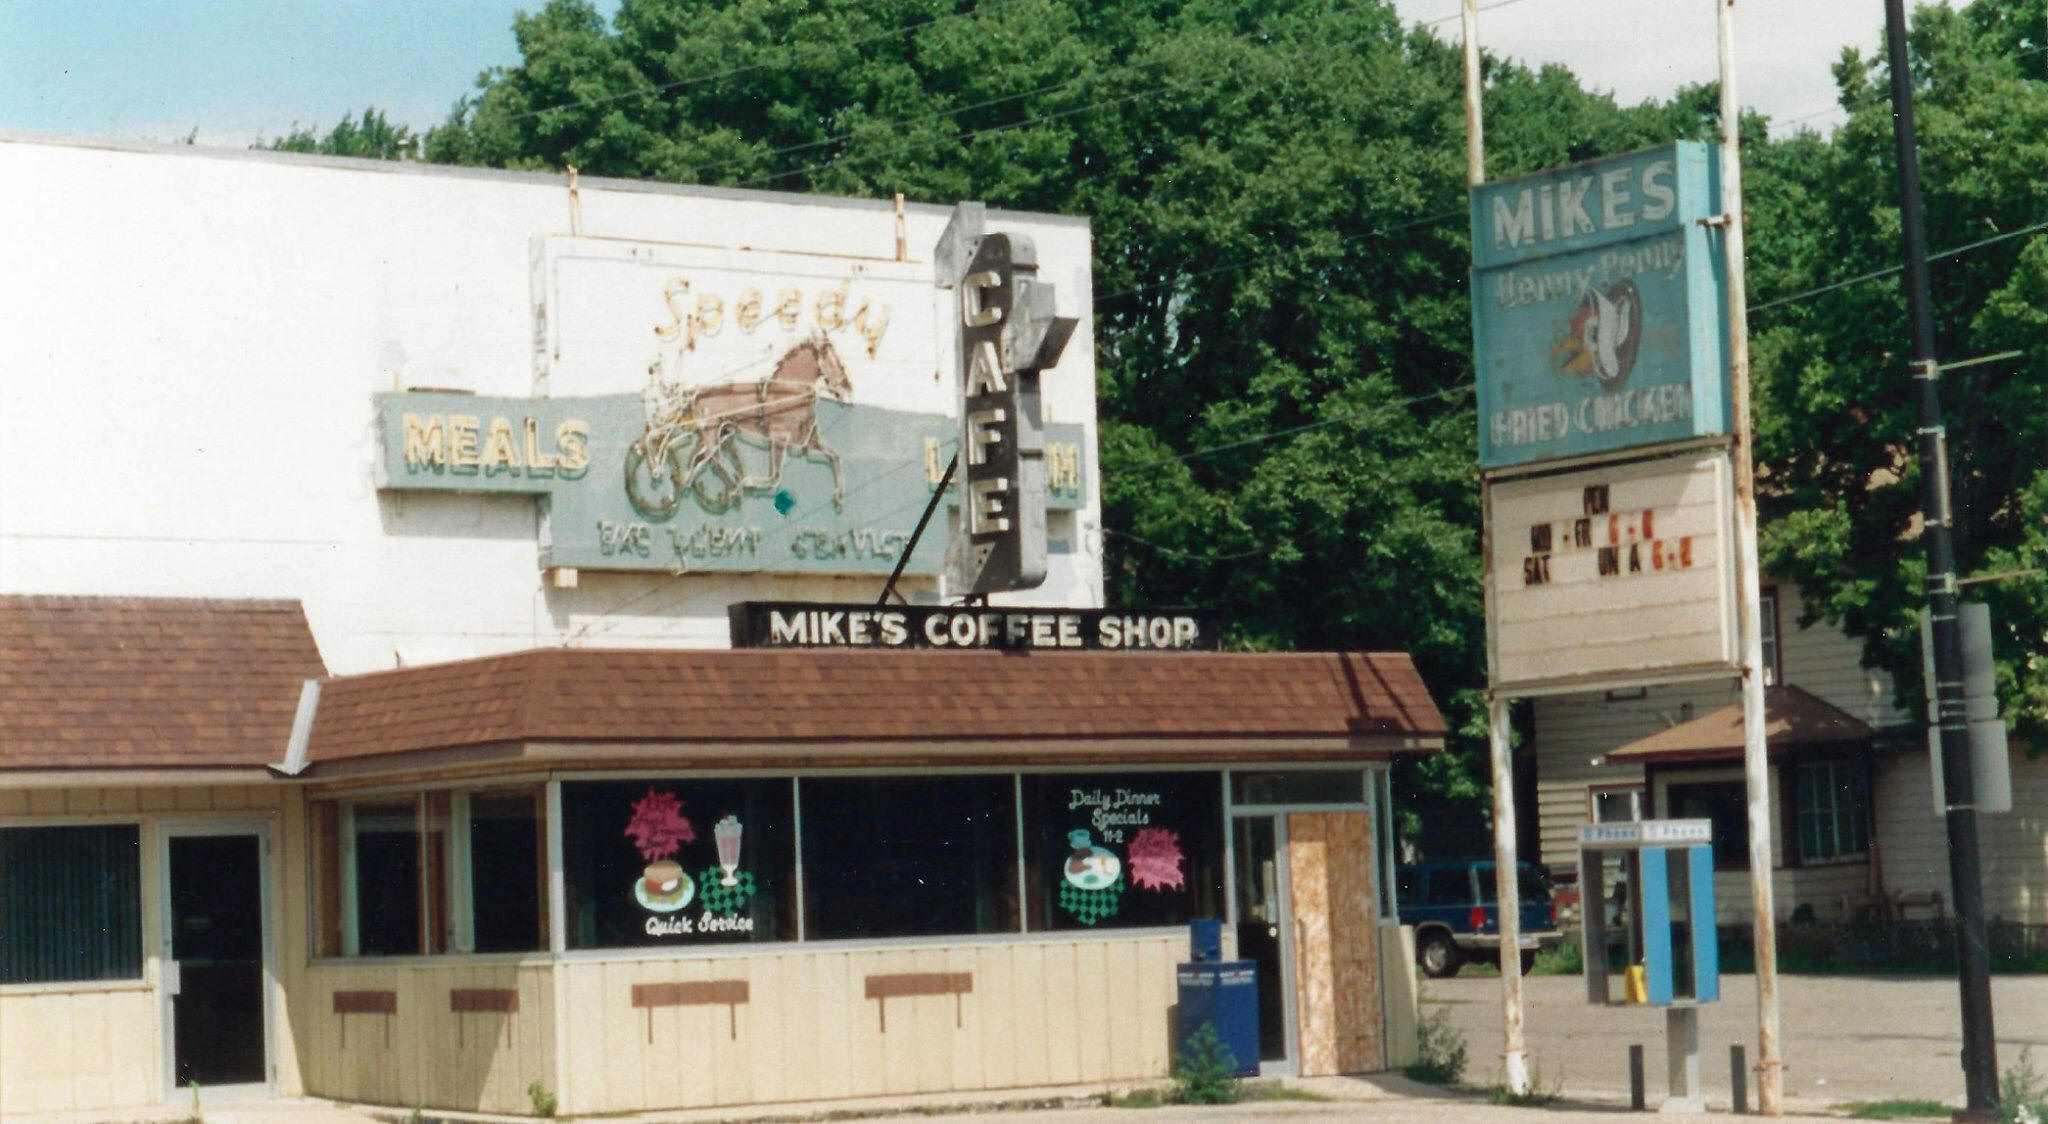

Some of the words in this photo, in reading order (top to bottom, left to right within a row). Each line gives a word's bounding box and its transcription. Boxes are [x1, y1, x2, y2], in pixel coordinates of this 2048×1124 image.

[654, 276, 889, 360] Speedy
[963, 270, 1010, 536] CAFE
[1490, 402, 1569, 446] FRIED
[1575, 384, 1693, 434] CHICKEN
[403, 413, 590, 471] MEALS
[1524, 555, 1550, 586] SAT
[769, 610, 908, 646] MIKE'S
[924, 612, 1083, 648] COFFEE
[1098, 616, 1200, 649] SHOP
[1068, 789, 1111, 810] Daily
[1114, 788, 1161, 809] Dinner
[1091, 808, 1149, 831] Specials
[645, 916, 693, 937] Quick
[698, 911, 753, 932] Service
